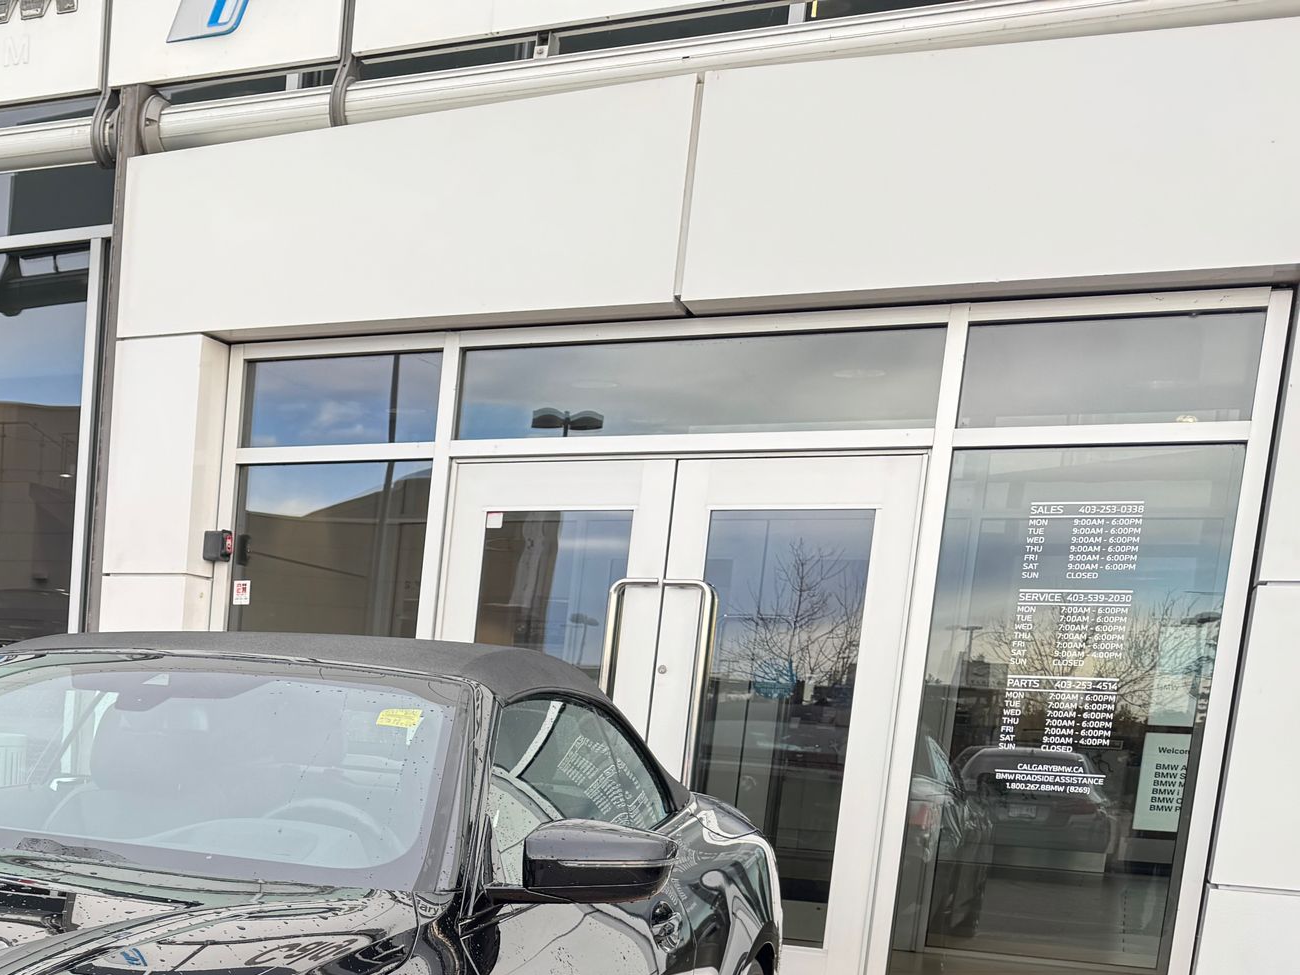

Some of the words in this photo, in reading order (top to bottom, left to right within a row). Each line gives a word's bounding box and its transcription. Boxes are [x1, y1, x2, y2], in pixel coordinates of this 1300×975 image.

[3, 34, 30, 67] M
[1031, 506, 1064, 514] SALES
[1079, 505, 1144, 513] 403-253-0338
[1019, 593, 1061, 601] SERVICE
[1067, 594, 1131, 602] 403-539-2030
[1007, 679, 1039, 688] PARTS
[1055, 681, 1117, 690] 403-253-4514
[1018, 764, 1083, 773] CALGARYBMW.CA
[1055, 777, 1104, 785] ASSISTANCE
[1067, 786, 1090, 794] (8269)
[1151, 796, 1174, 804] BMW
